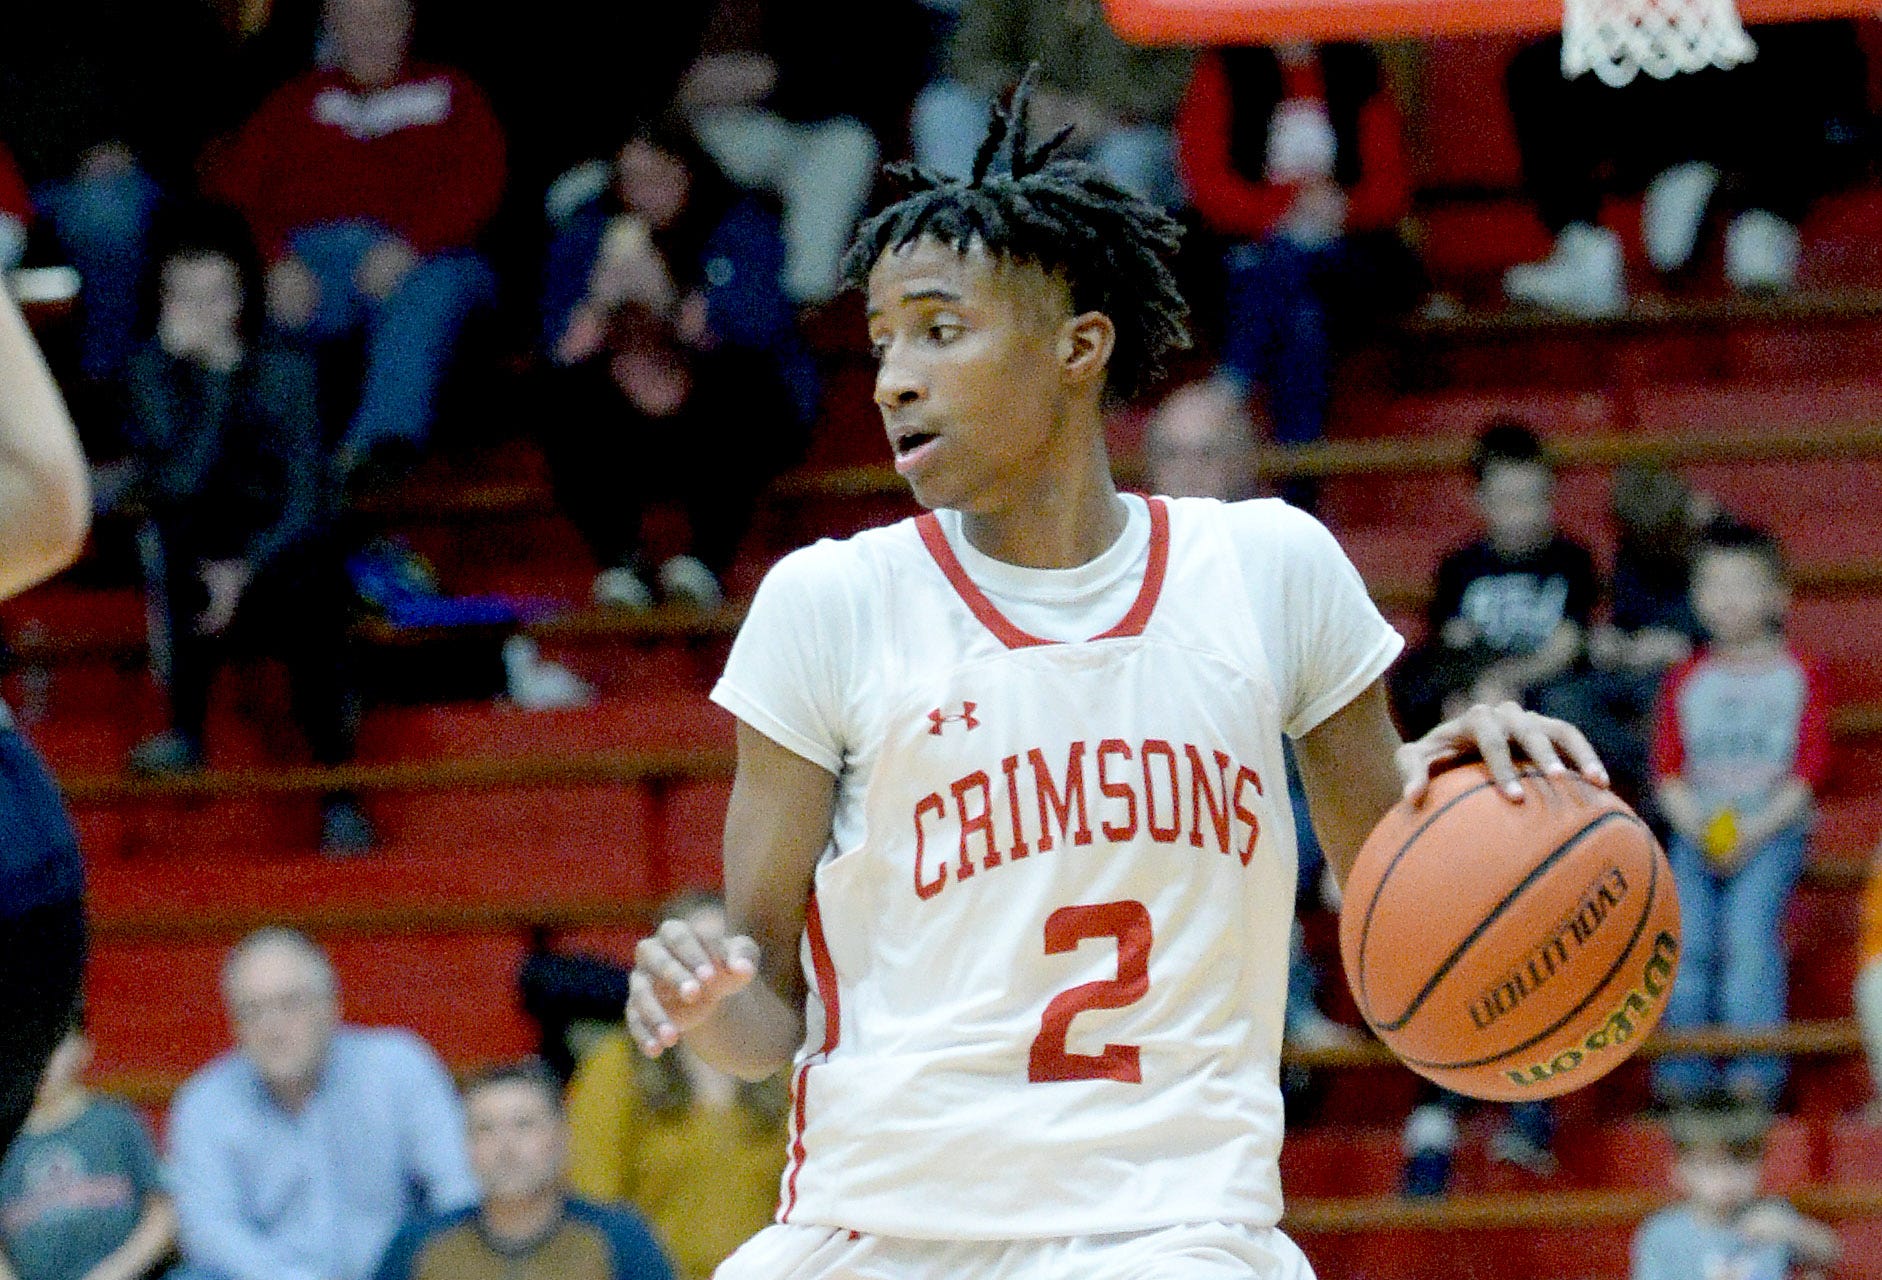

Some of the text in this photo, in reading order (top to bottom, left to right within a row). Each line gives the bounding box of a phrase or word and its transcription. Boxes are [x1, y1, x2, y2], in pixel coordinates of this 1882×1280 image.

[914, 739, 1264, 900] CRIMSONS
[1028, 900, 1153, 1084] 2
[1469, 867, 1629, 1030] EVOLUTION
[1507, 931, 1678, 1086] Wilson
